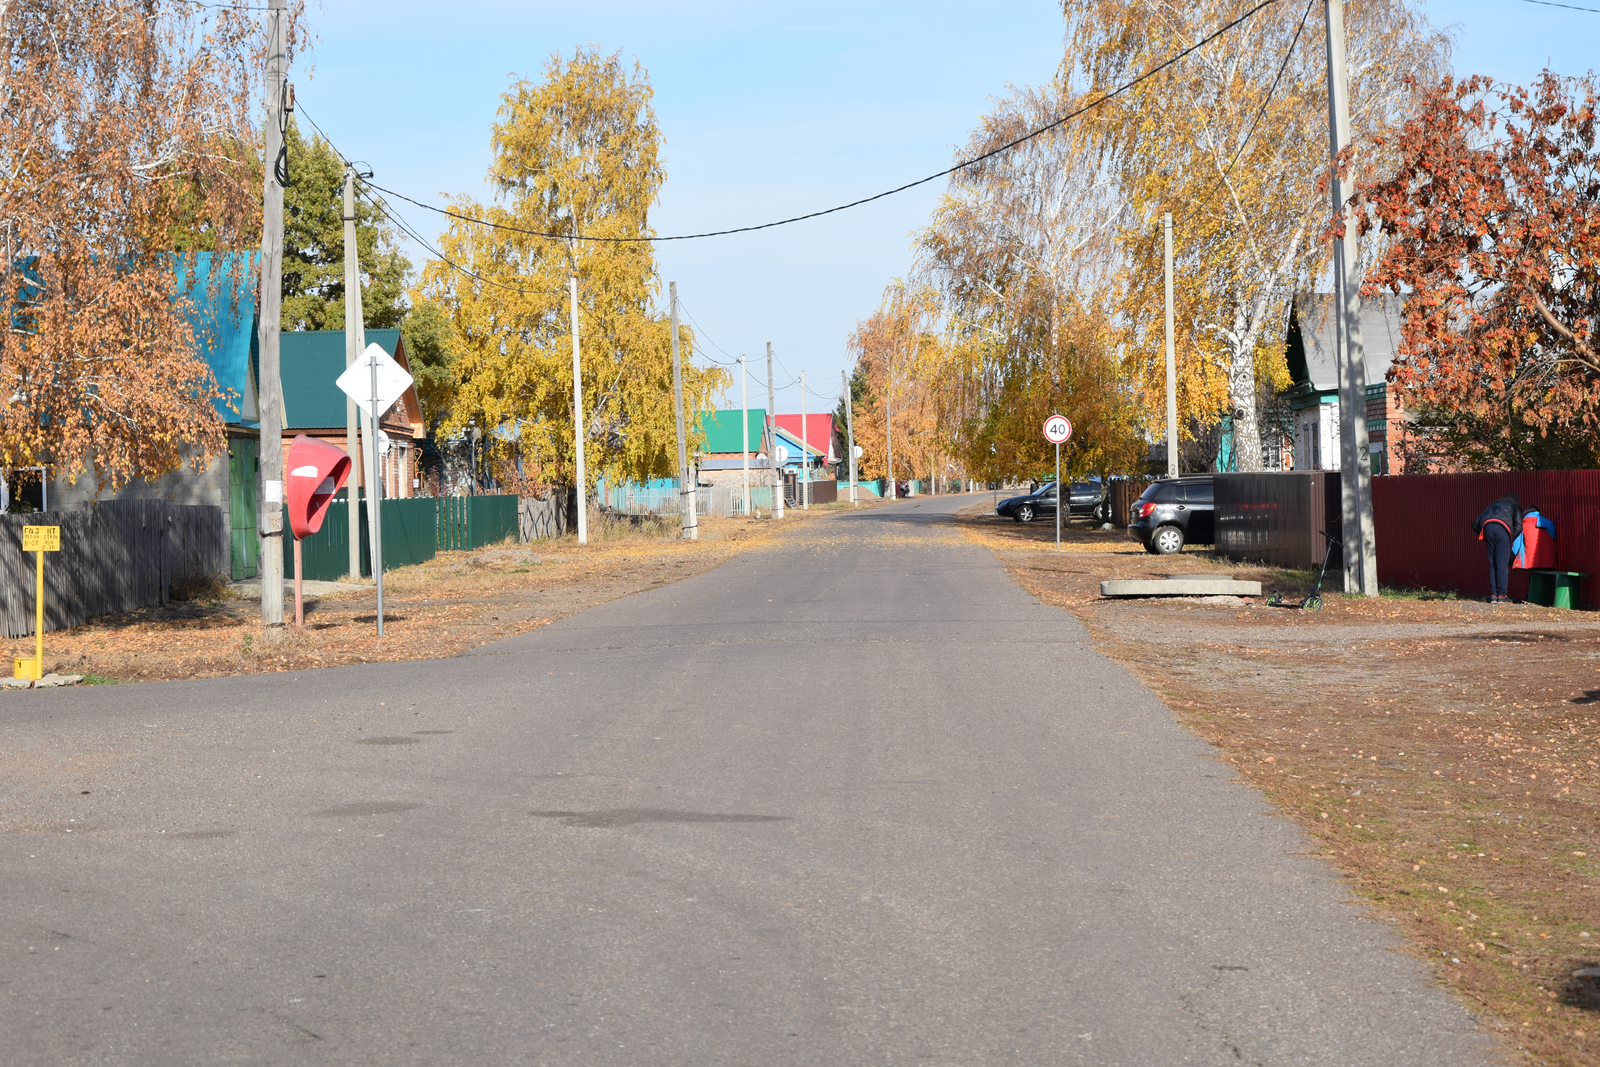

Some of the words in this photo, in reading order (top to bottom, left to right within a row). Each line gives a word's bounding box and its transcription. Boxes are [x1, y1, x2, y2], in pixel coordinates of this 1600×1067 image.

[1050, 424, 1066, 435] 40
[1360, 446, 1368, 460] 2
[578, 478, 584, 488] 2
